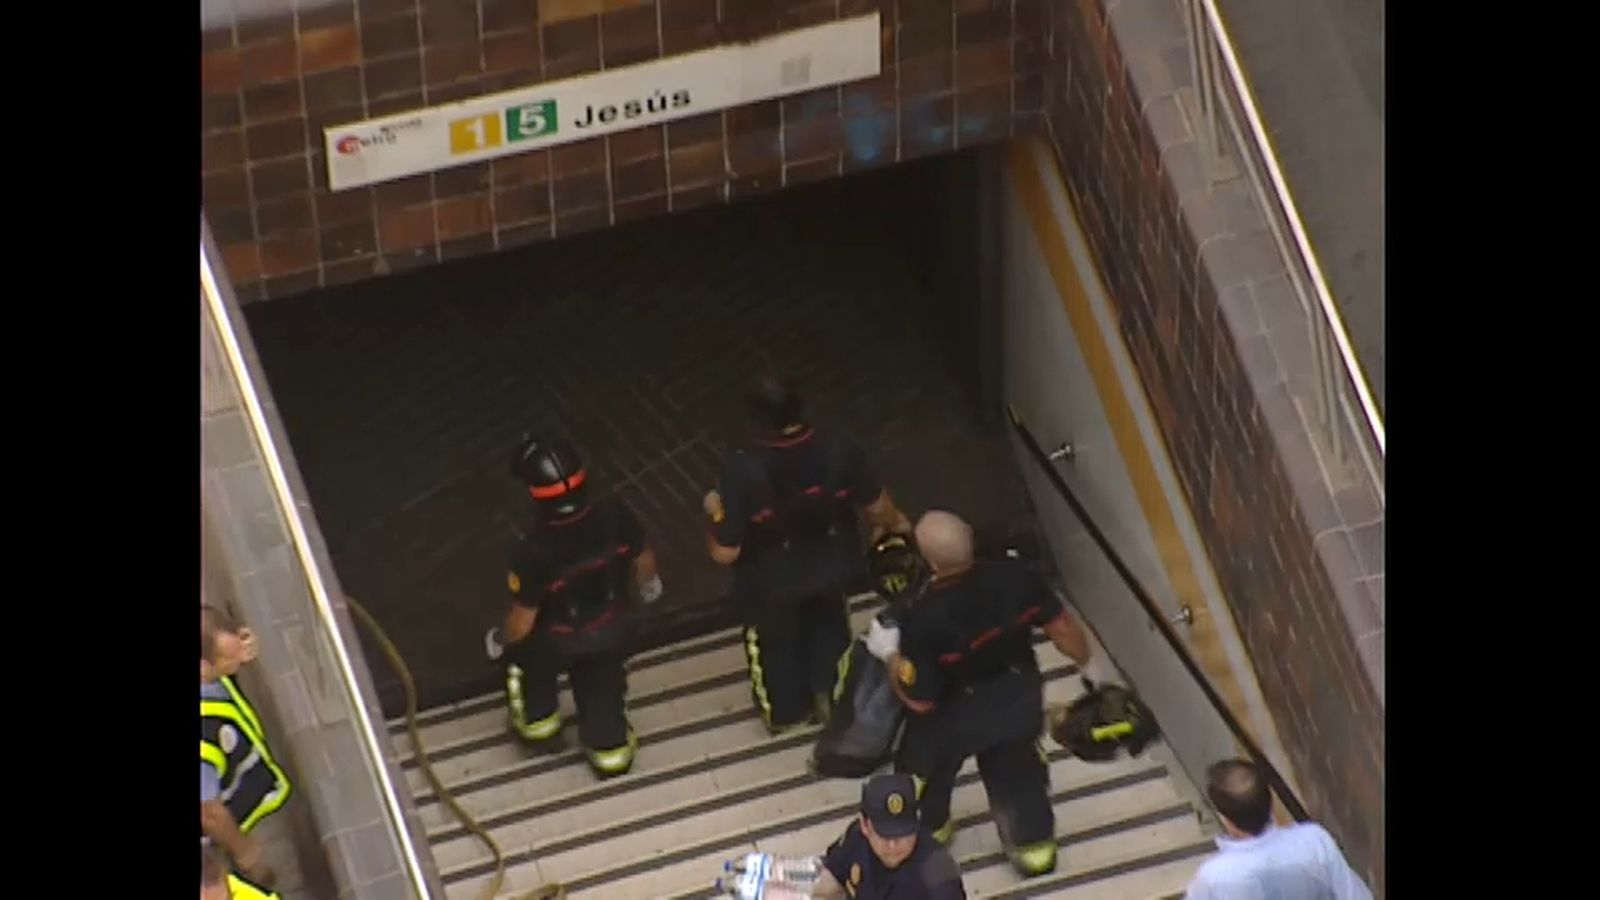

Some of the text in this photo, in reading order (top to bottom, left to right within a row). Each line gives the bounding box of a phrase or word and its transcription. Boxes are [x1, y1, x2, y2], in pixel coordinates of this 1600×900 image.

[464, 89, 691, 149] 1 5 Jesús
